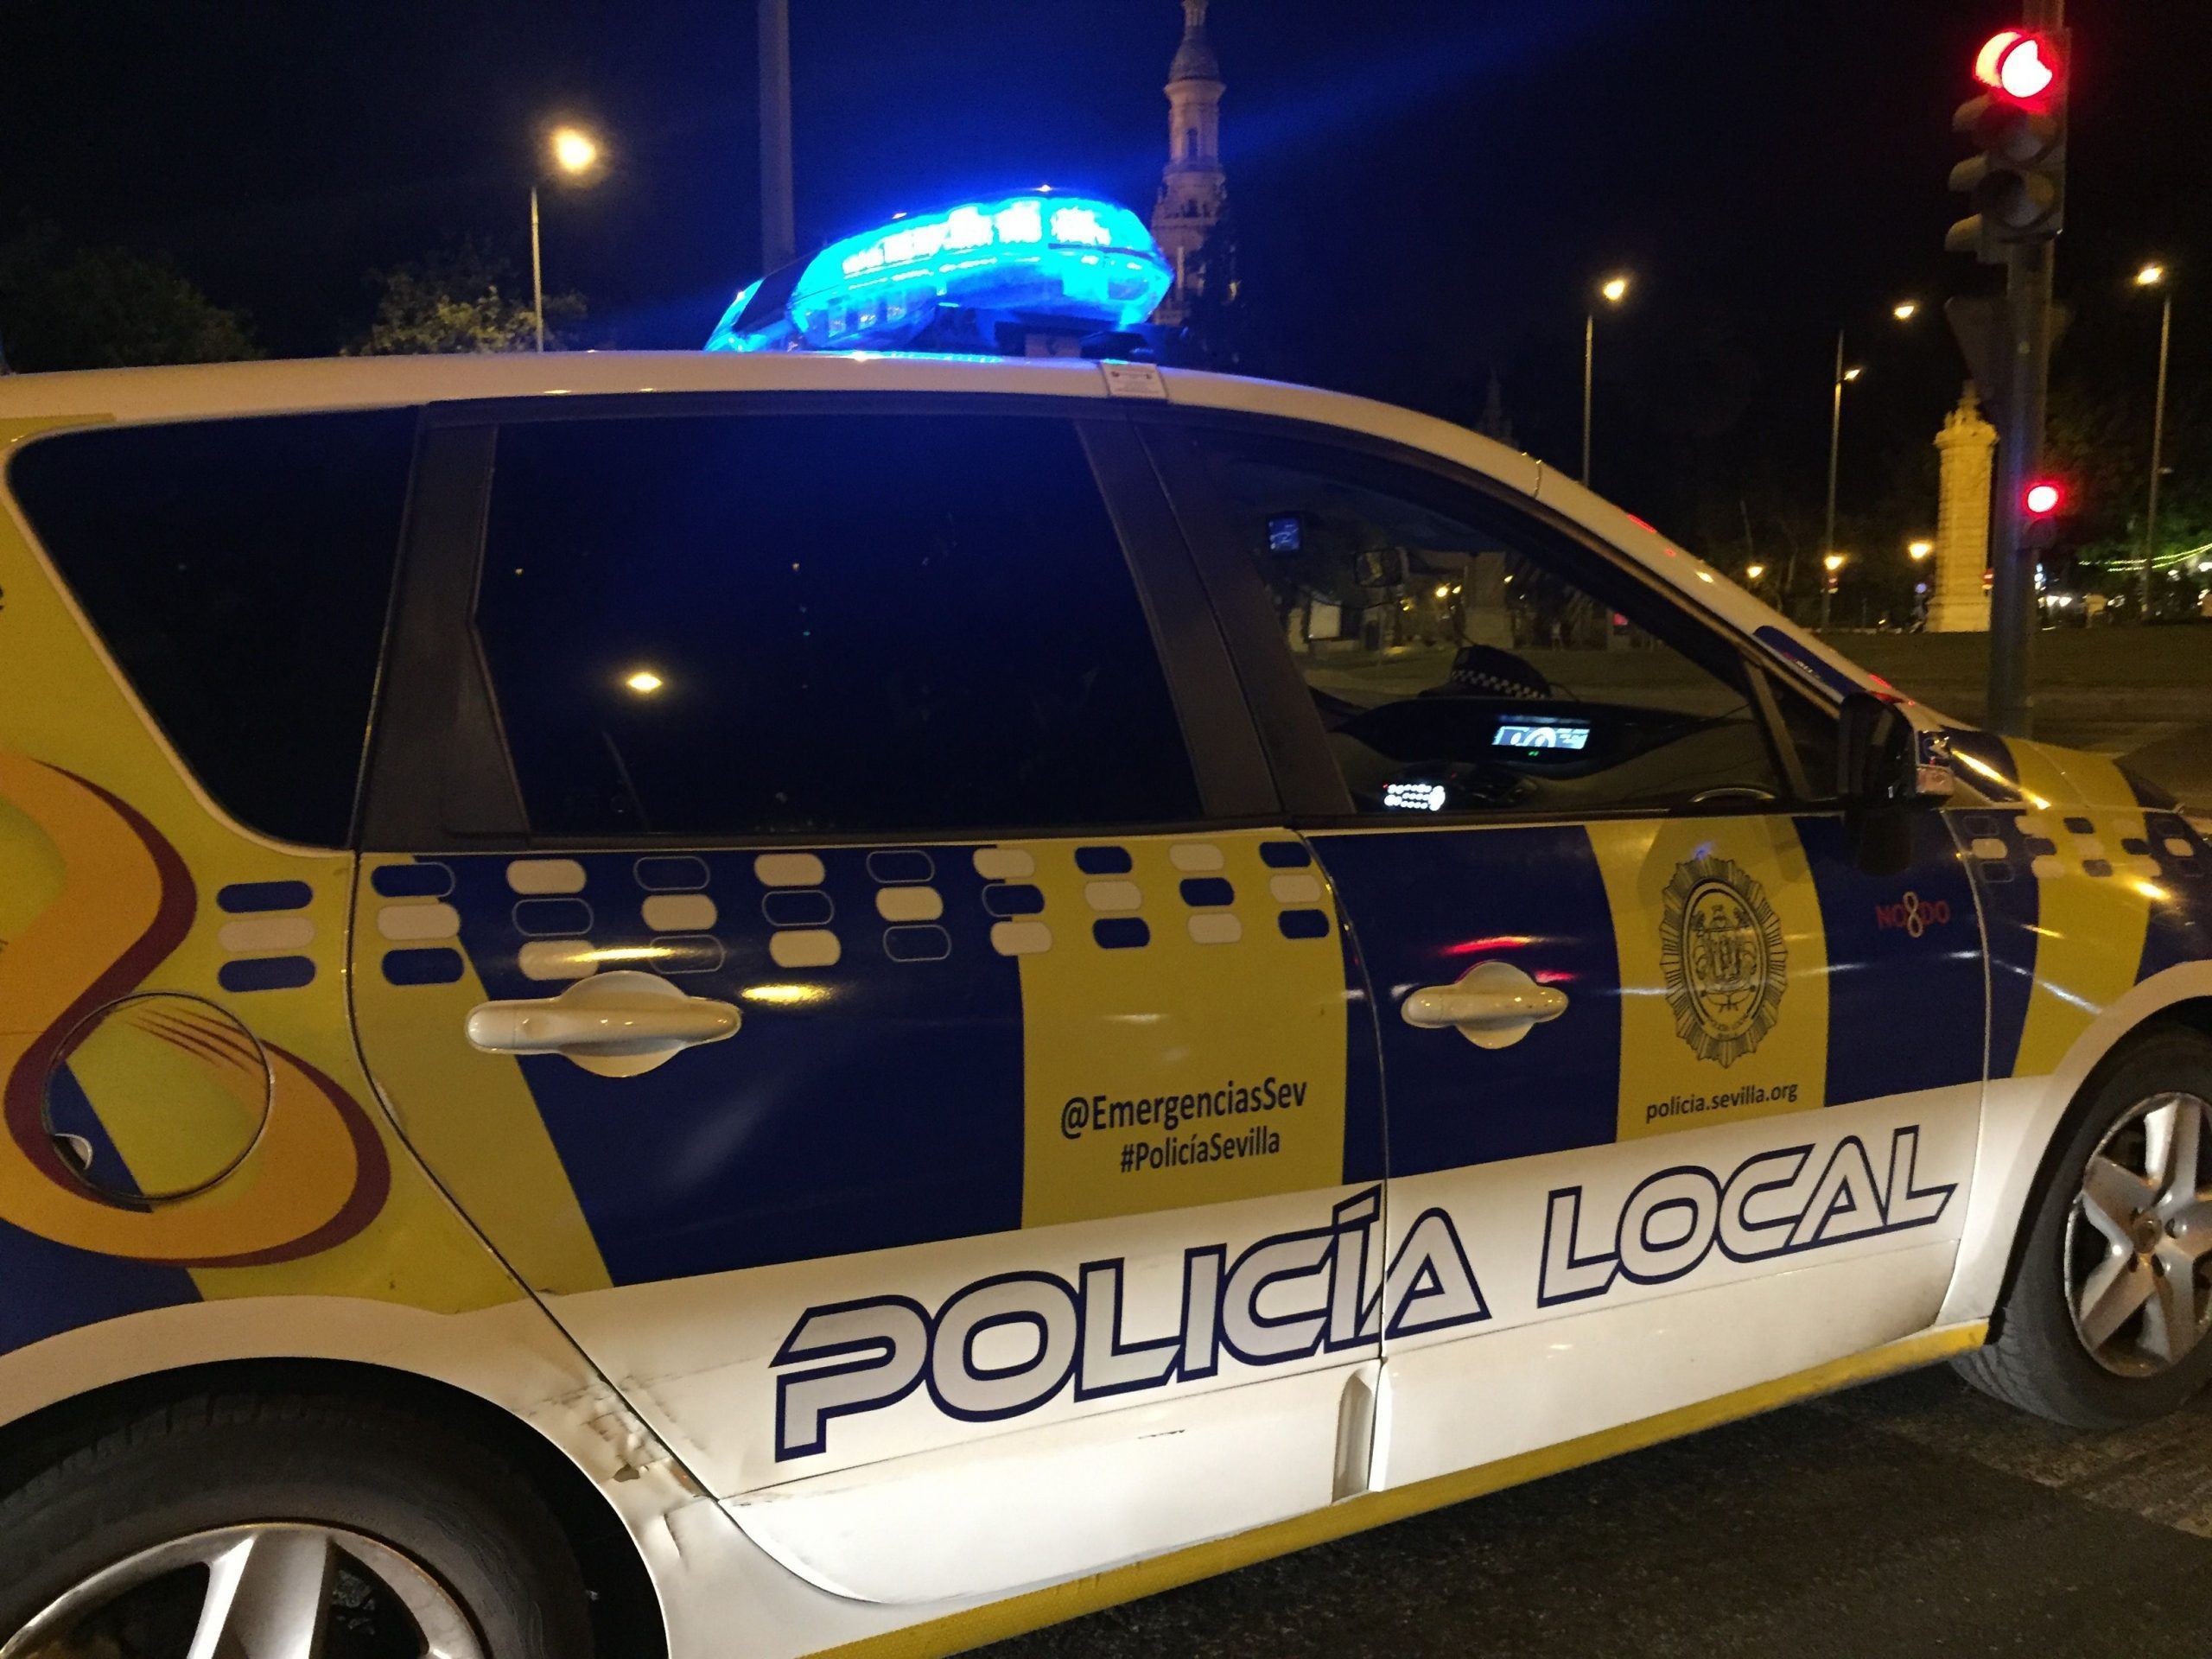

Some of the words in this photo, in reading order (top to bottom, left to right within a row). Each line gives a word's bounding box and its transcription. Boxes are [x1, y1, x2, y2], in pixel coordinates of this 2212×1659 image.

[1061, 1077, 1307, 1140] @EmergenciasSev
[1646, 1084, 1798, 1123] policia.sevilla.org
[1121, 1125, 1281, 1173] #PolicíaSevilla
[768, 1183, 1491, 1462] POLICÍA
[1537, 1125, 1959, 1308] LOCAL
